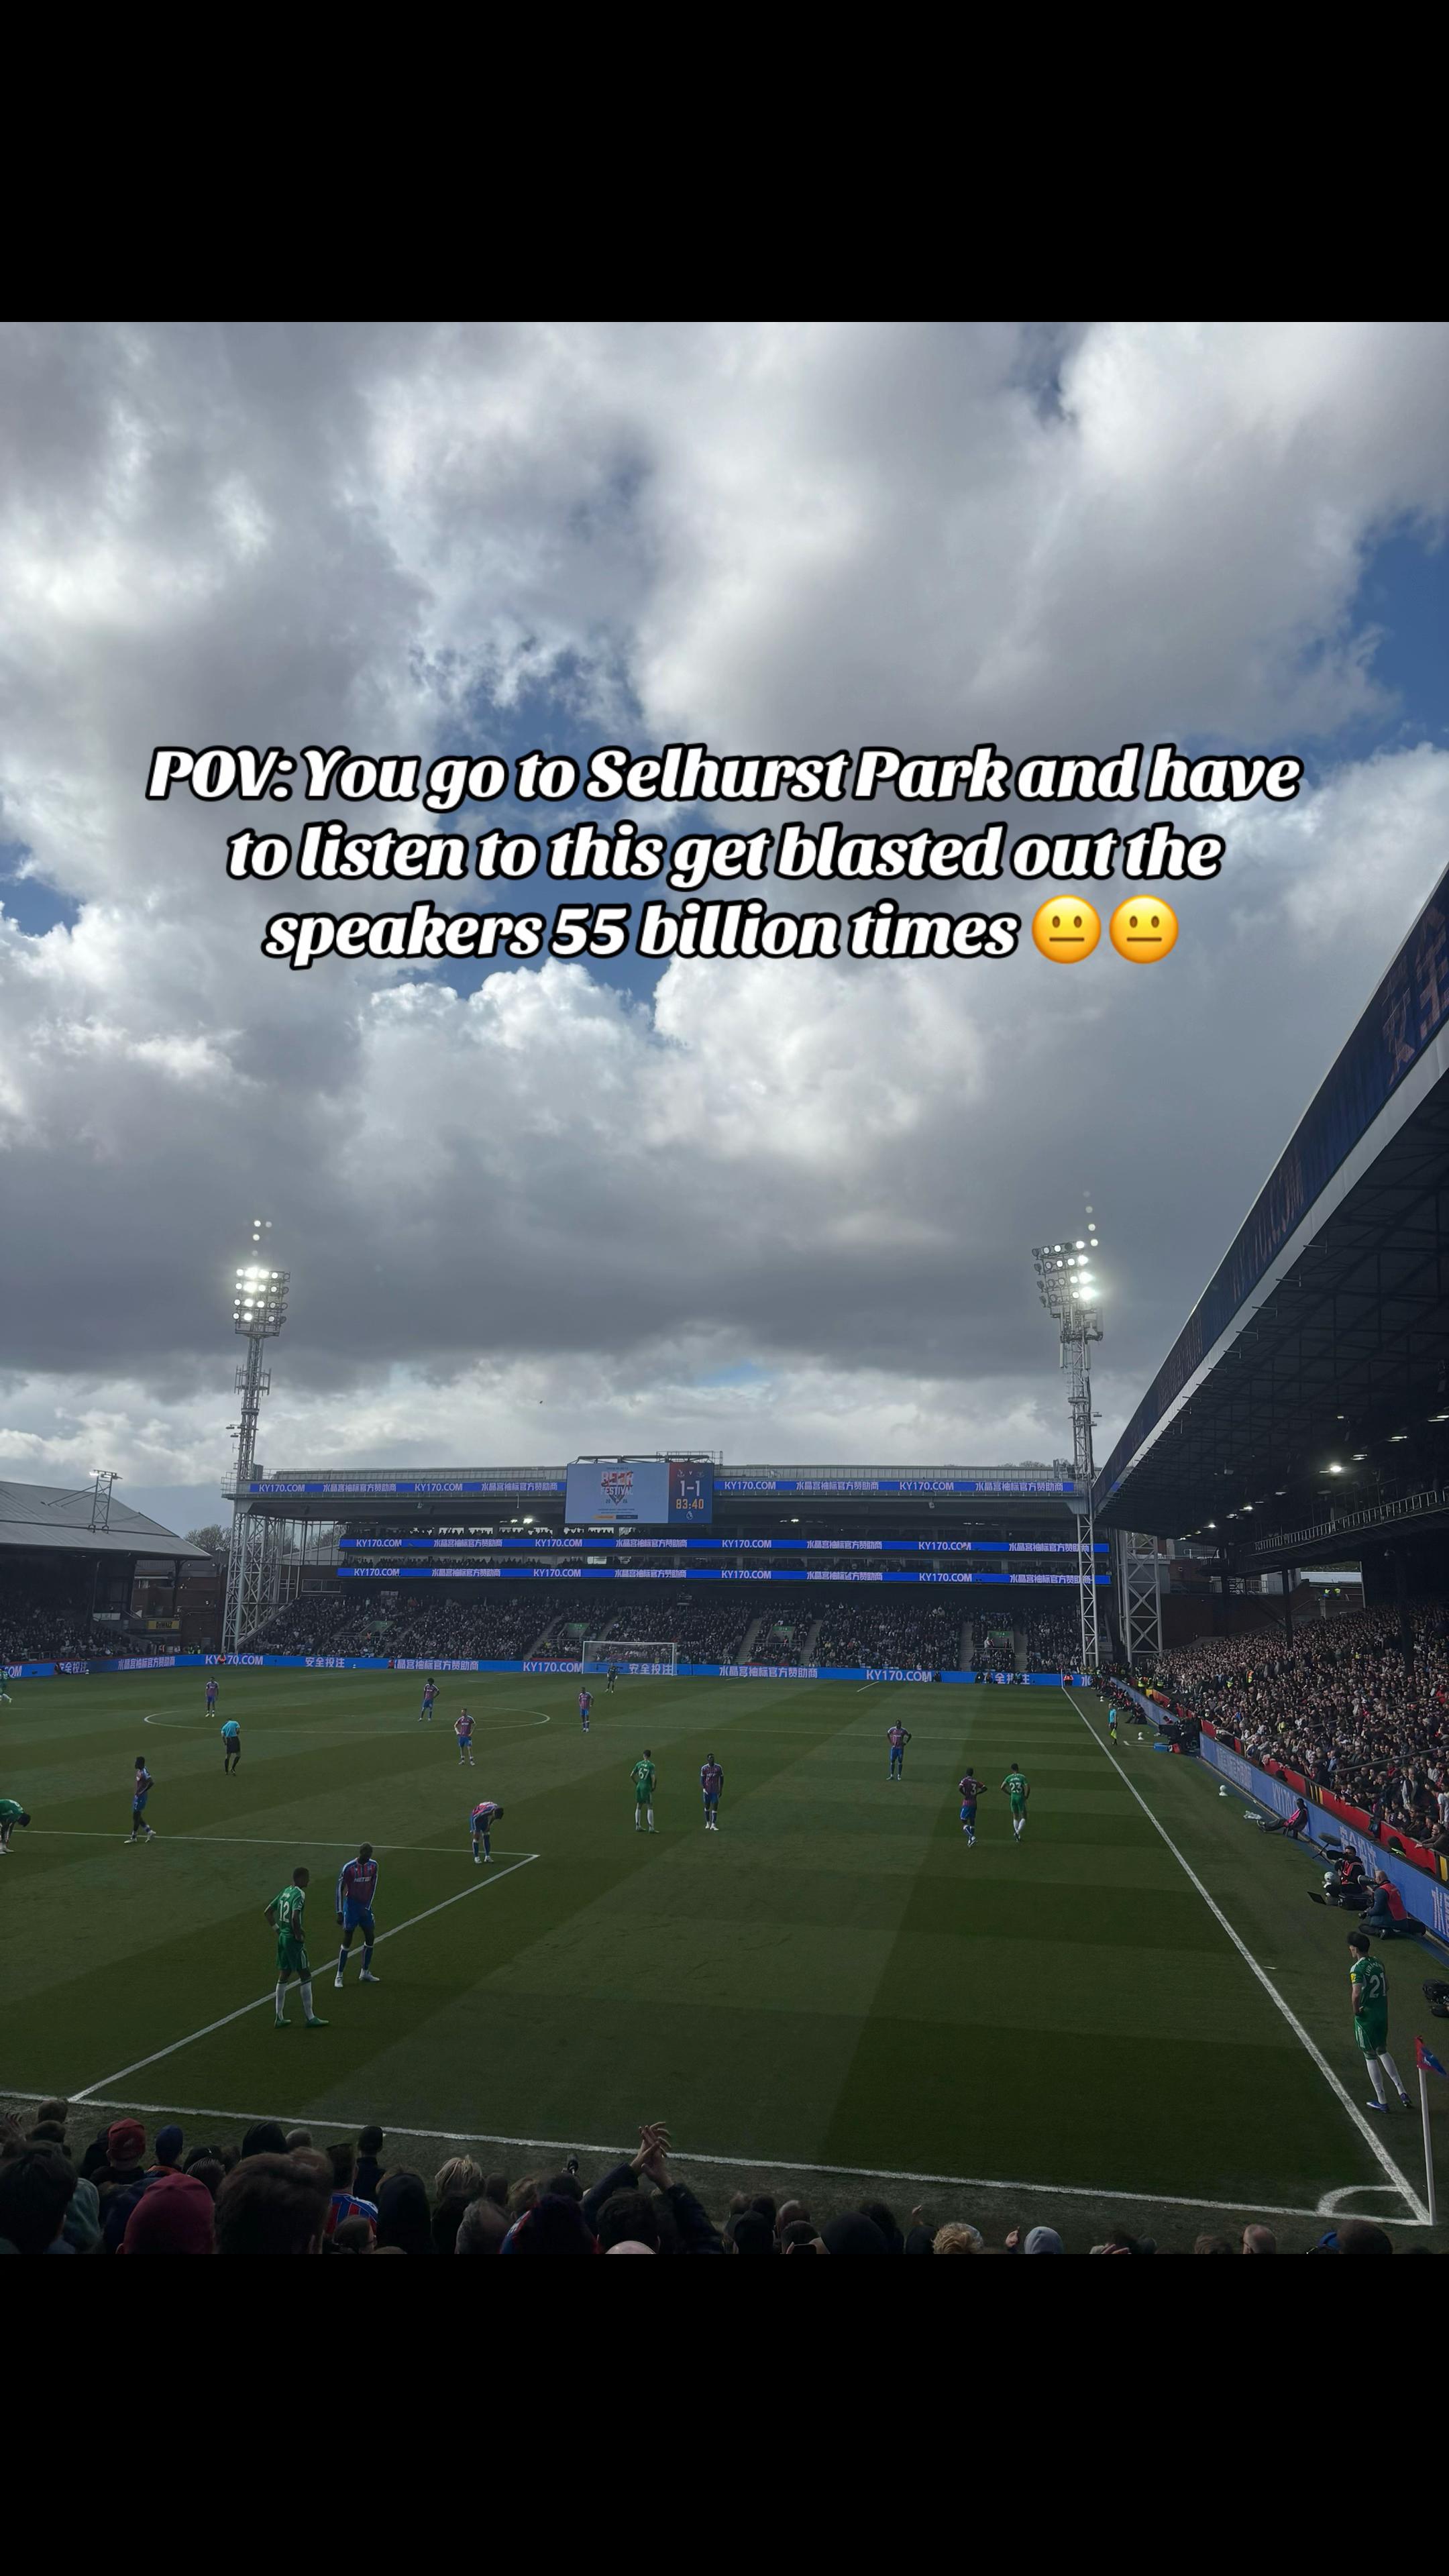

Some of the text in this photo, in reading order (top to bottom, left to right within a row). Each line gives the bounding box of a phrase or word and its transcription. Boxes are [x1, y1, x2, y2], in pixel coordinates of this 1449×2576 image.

[259, 1484, 305, 1492] KY170.COM
[415, 1483, 463, 1491] KY170.COM
[724, 1481, 776, 1490] KY170.COM
[899, 1481, 954, 1491] KY170.COM
[601, 1487, 633, 1495] FESTIVAL
[676, 1499, 704, 1509] 83:40
[356, 1539, 402, 1547] KY170.COM
[535, 1539, 582, 1547] KY170.COM
[722, 1540, 771, 1548] KY170.COM
[918, 1542, 971, 1550] KY170.COM
[354, 1568, 400, 1576] KY170.COM
[533, 1568, 581, 1577] KY170.COM
[721, 1570, 771, 1579] KY170.COM
[919, 1572, 972, 1582] KY170.COM
[205, 1655, 264, 1665] KY70.COM
[305, 1657, 345, 1668] 安全投注
[523, 1662, 582, 1673] KY170.COM
[866, 1669, 932, 1682] KY170.COM
[638, 1768, 649, 1780] 67
[1009, 1782, 1022, 1793] 23
[279, 1900, 290, 1923] 12
[1369, 1972, 1387, 1998] 21
